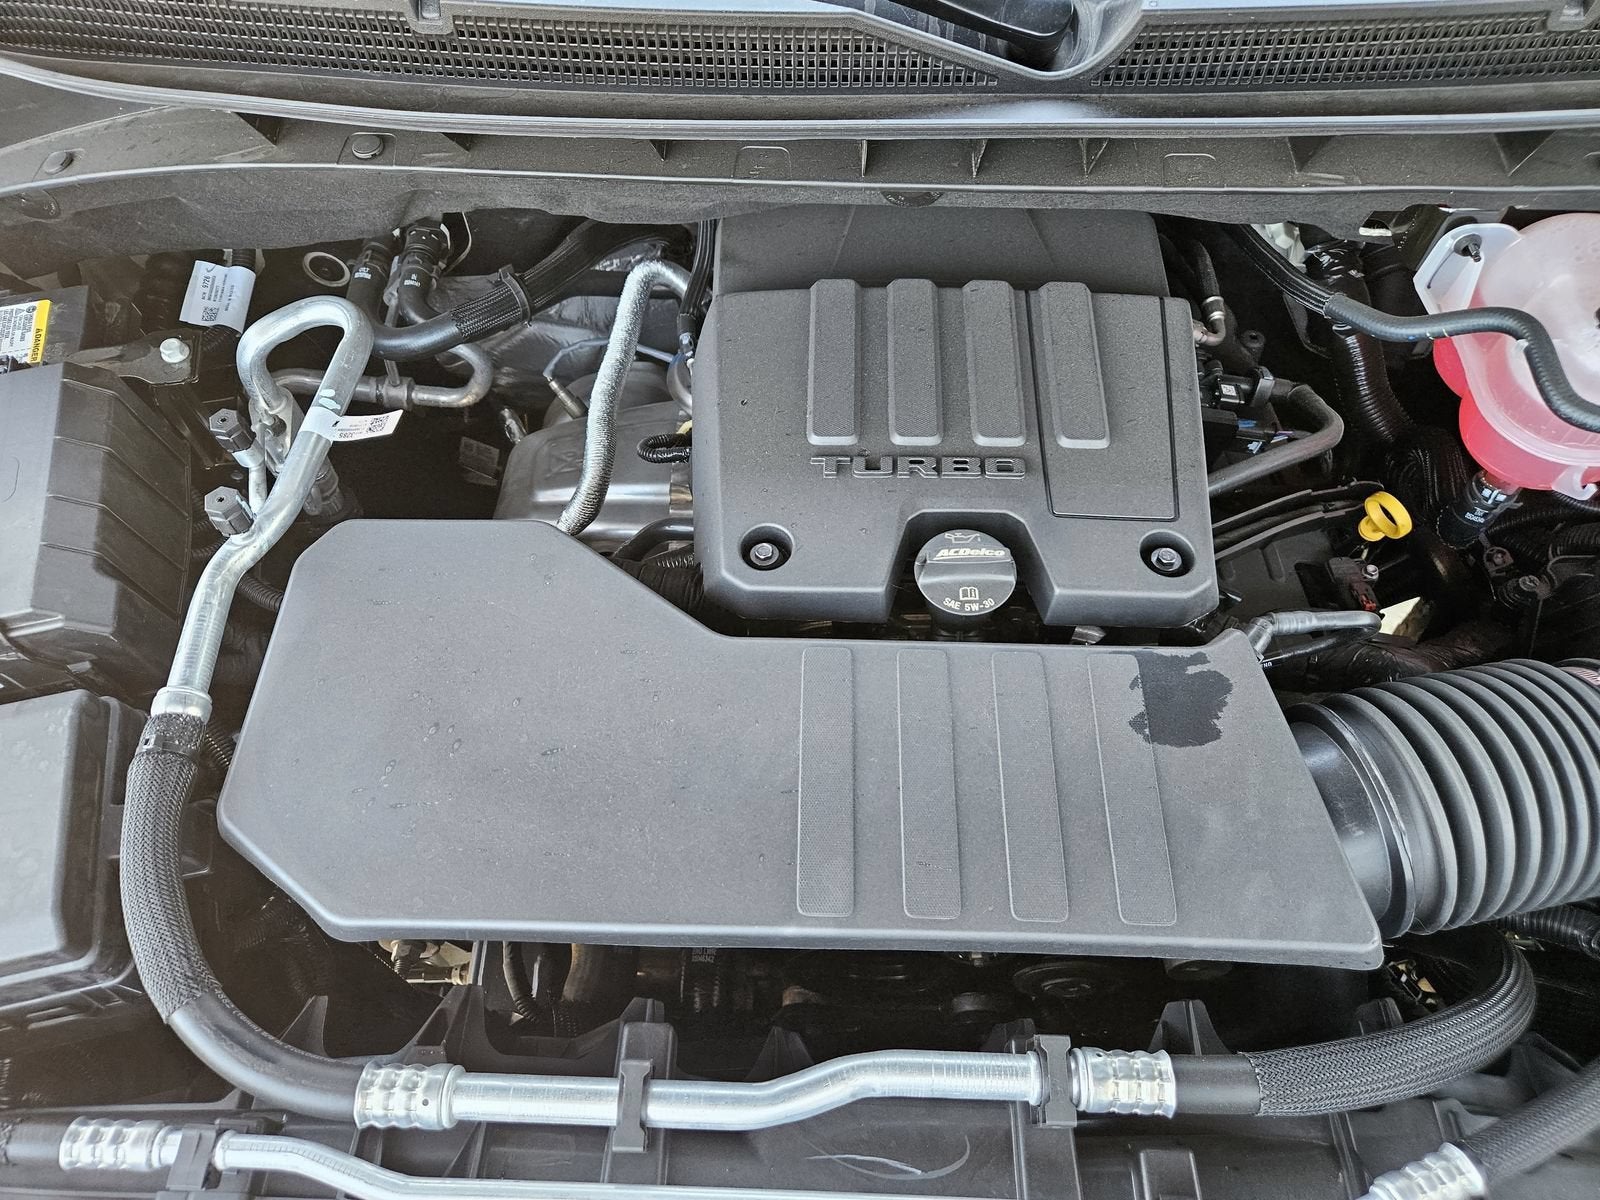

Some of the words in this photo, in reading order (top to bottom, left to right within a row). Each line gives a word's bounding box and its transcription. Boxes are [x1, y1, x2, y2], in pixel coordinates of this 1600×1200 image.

[30, 333, 42, 362] DANGER
[810, 456, 1025, 479] TURBO
[935, 547, 1006, 558] ACDelco
[942, 597, 962, 610] SAE
[964, 597, 995, 611] 5W-30
